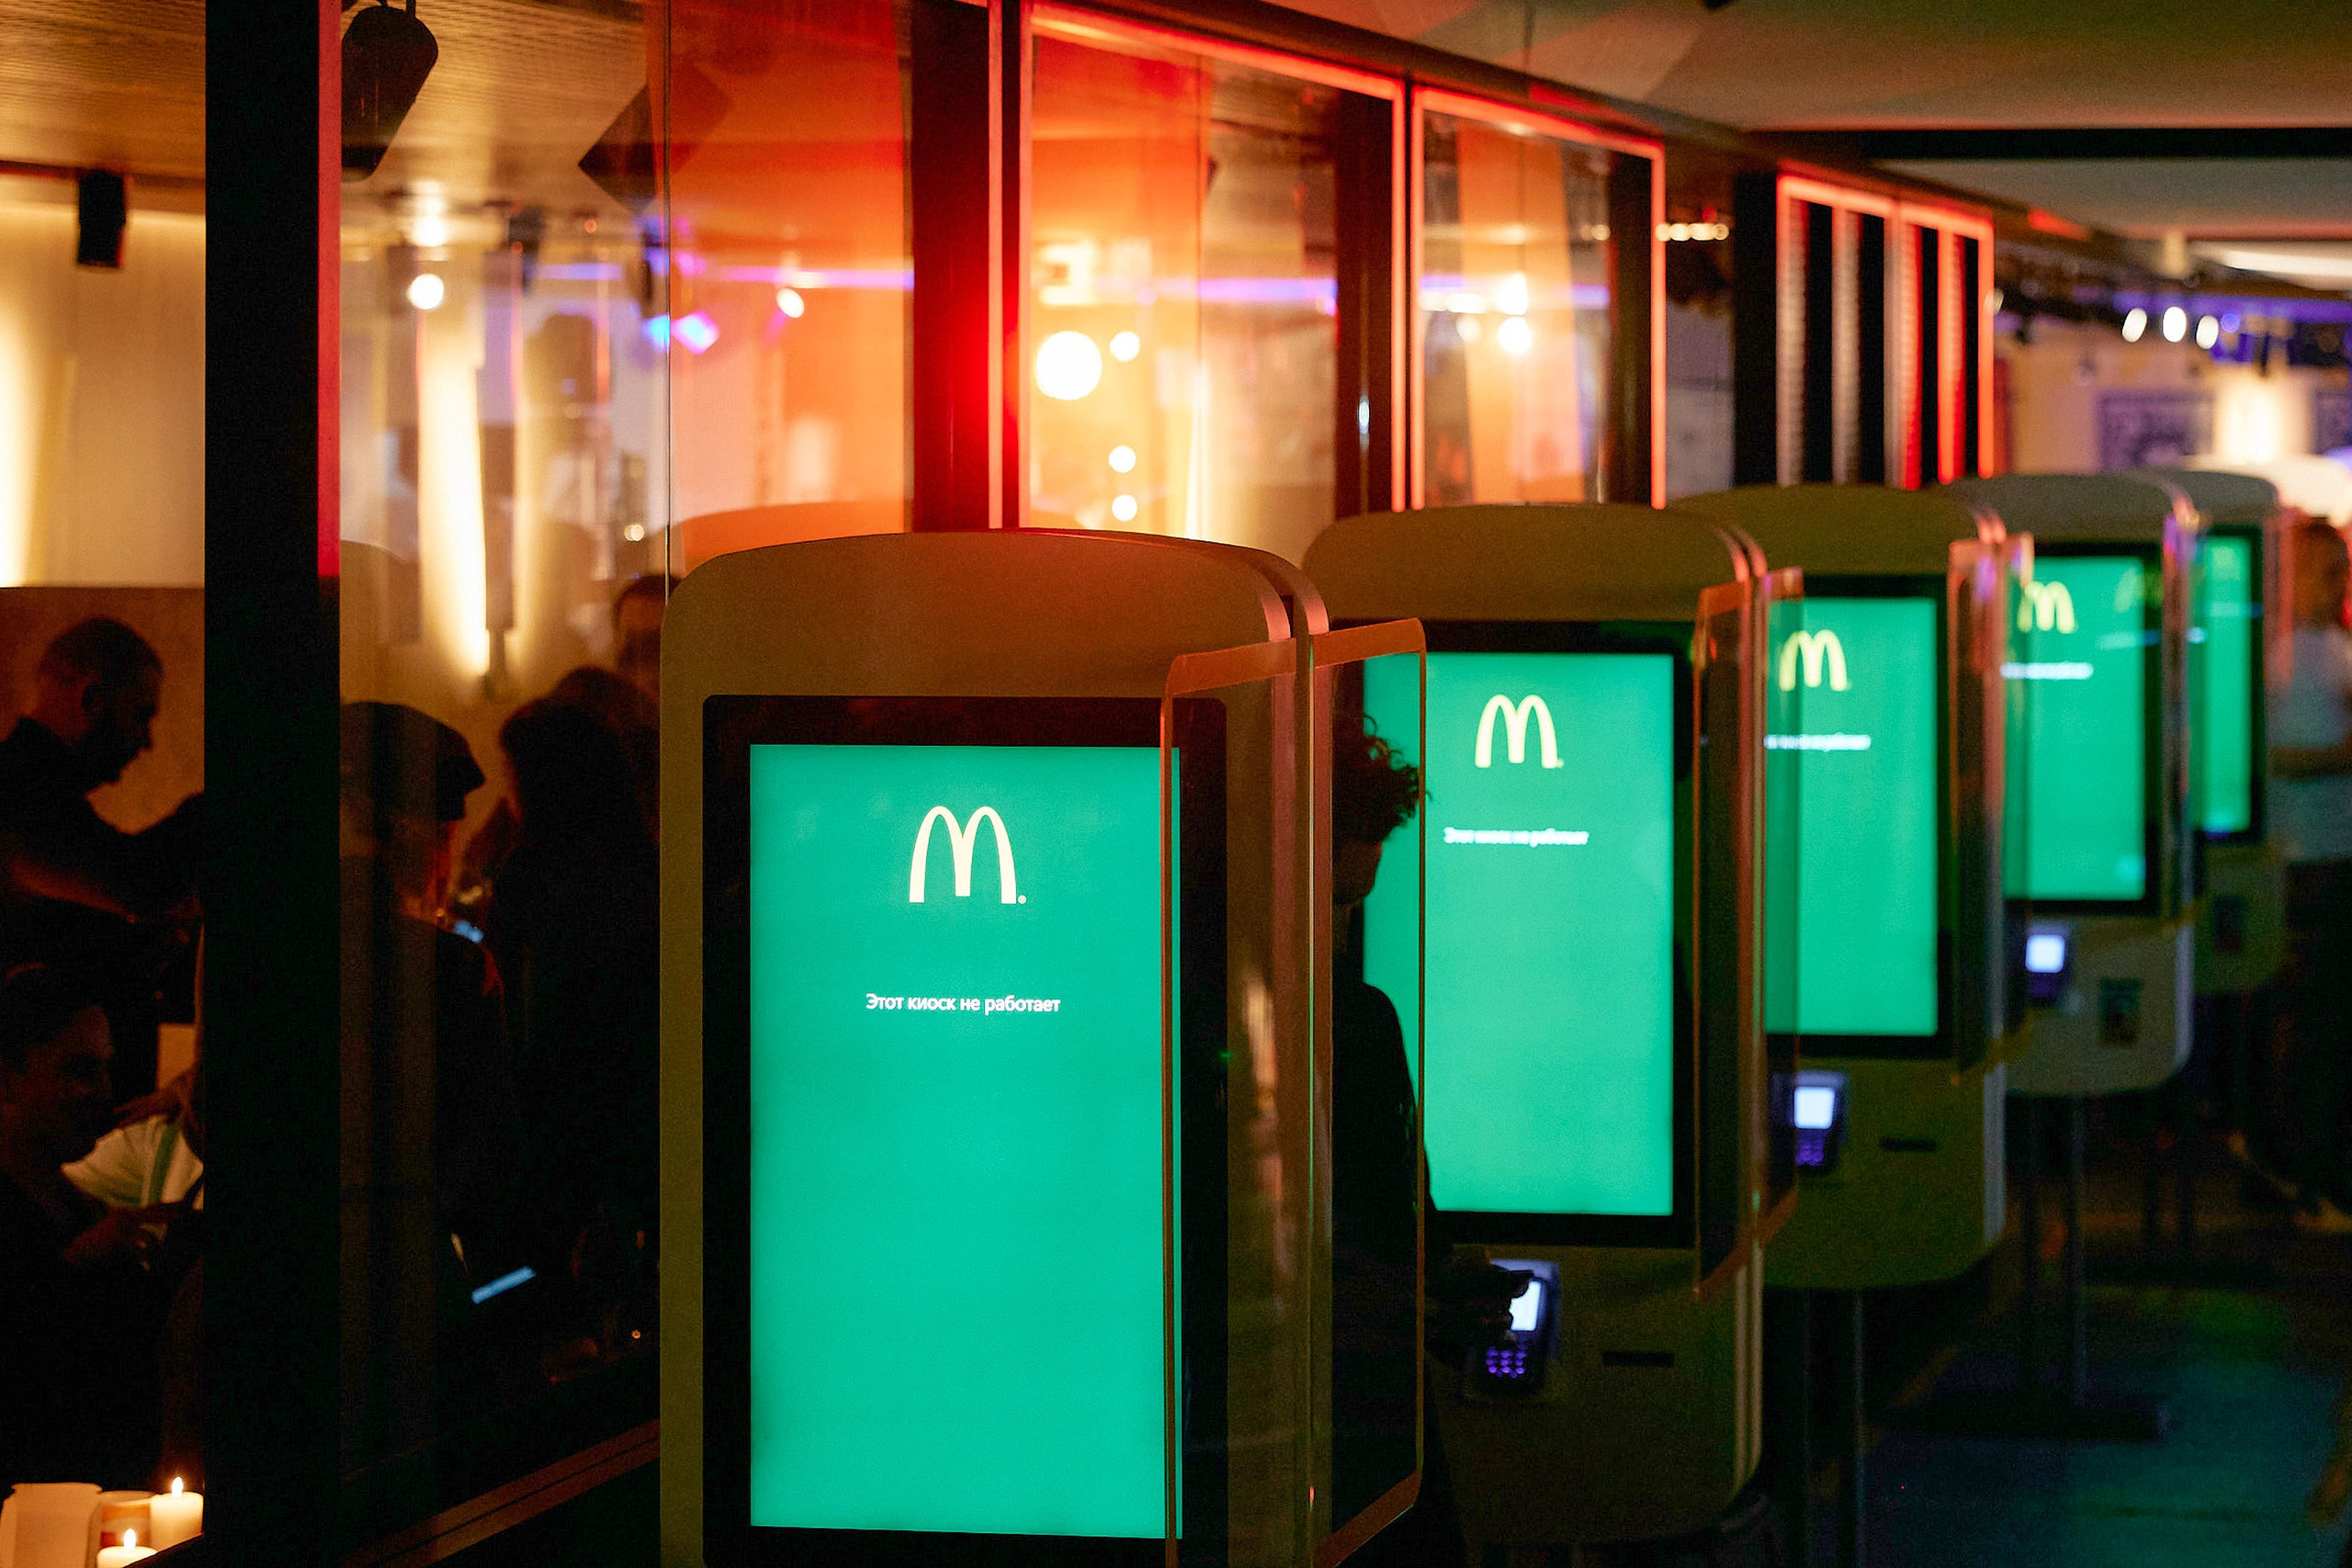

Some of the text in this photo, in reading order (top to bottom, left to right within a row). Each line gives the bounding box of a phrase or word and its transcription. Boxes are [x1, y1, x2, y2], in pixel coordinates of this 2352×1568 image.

[865, 993, 1061, 1016] Этот киоск не работает
